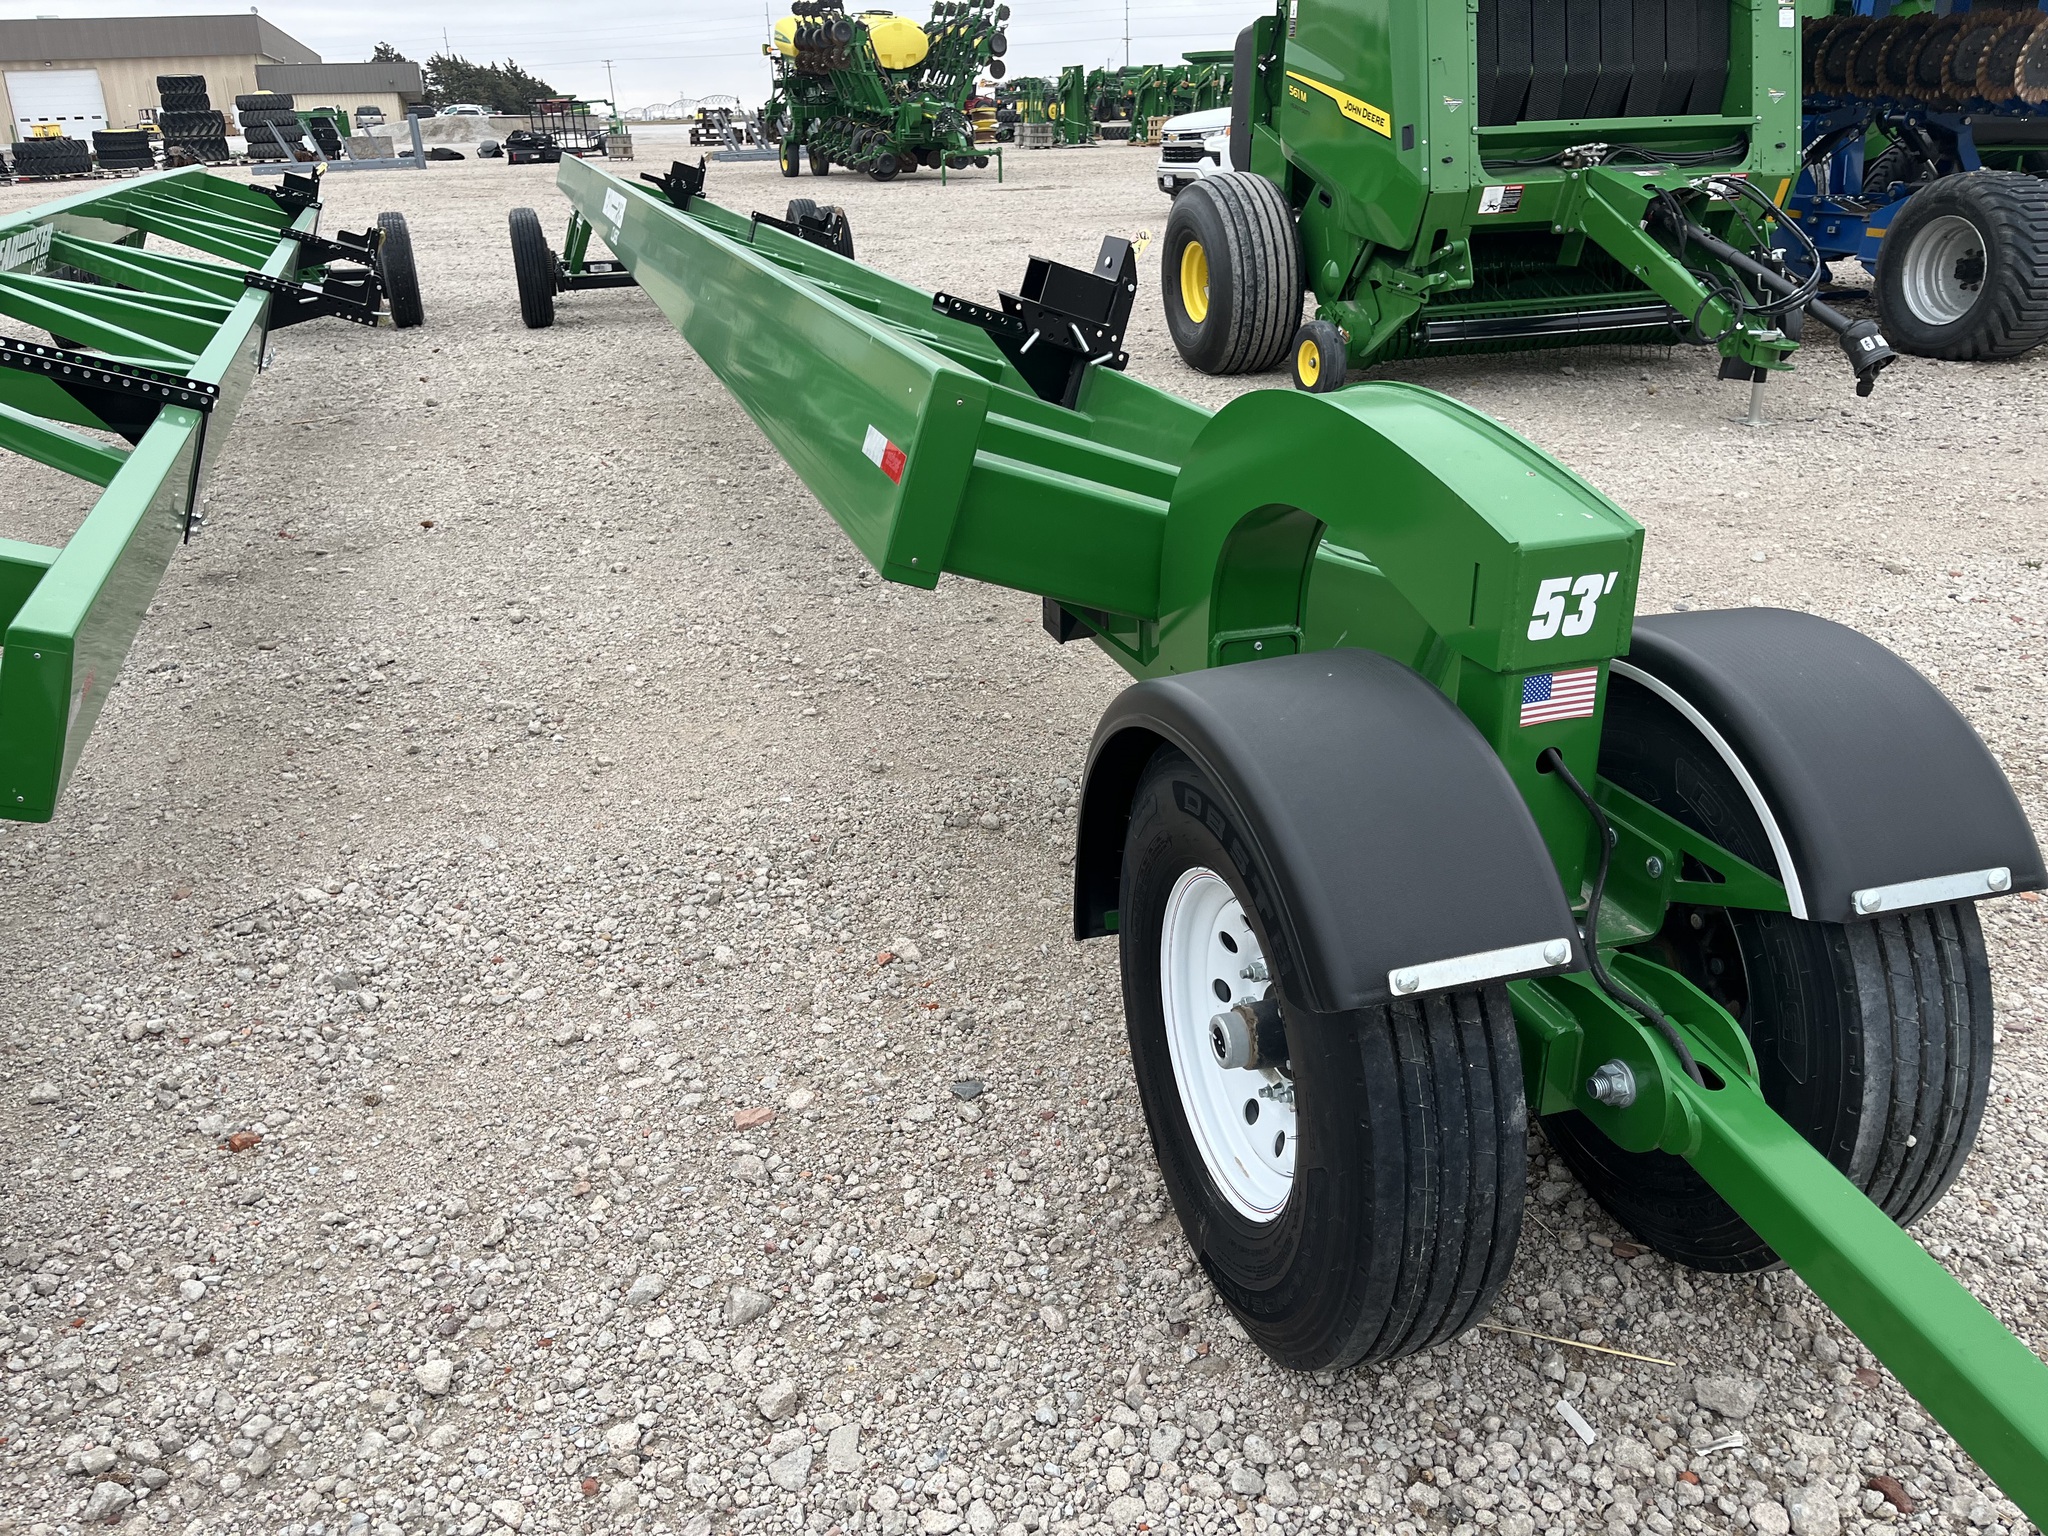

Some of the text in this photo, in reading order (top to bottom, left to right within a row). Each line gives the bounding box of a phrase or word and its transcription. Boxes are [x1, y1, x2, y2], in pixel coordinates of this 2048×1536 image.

[1343, 99, 1386, 128] JOHN DEERE
[1526, 571, 1619, 641] 53'
